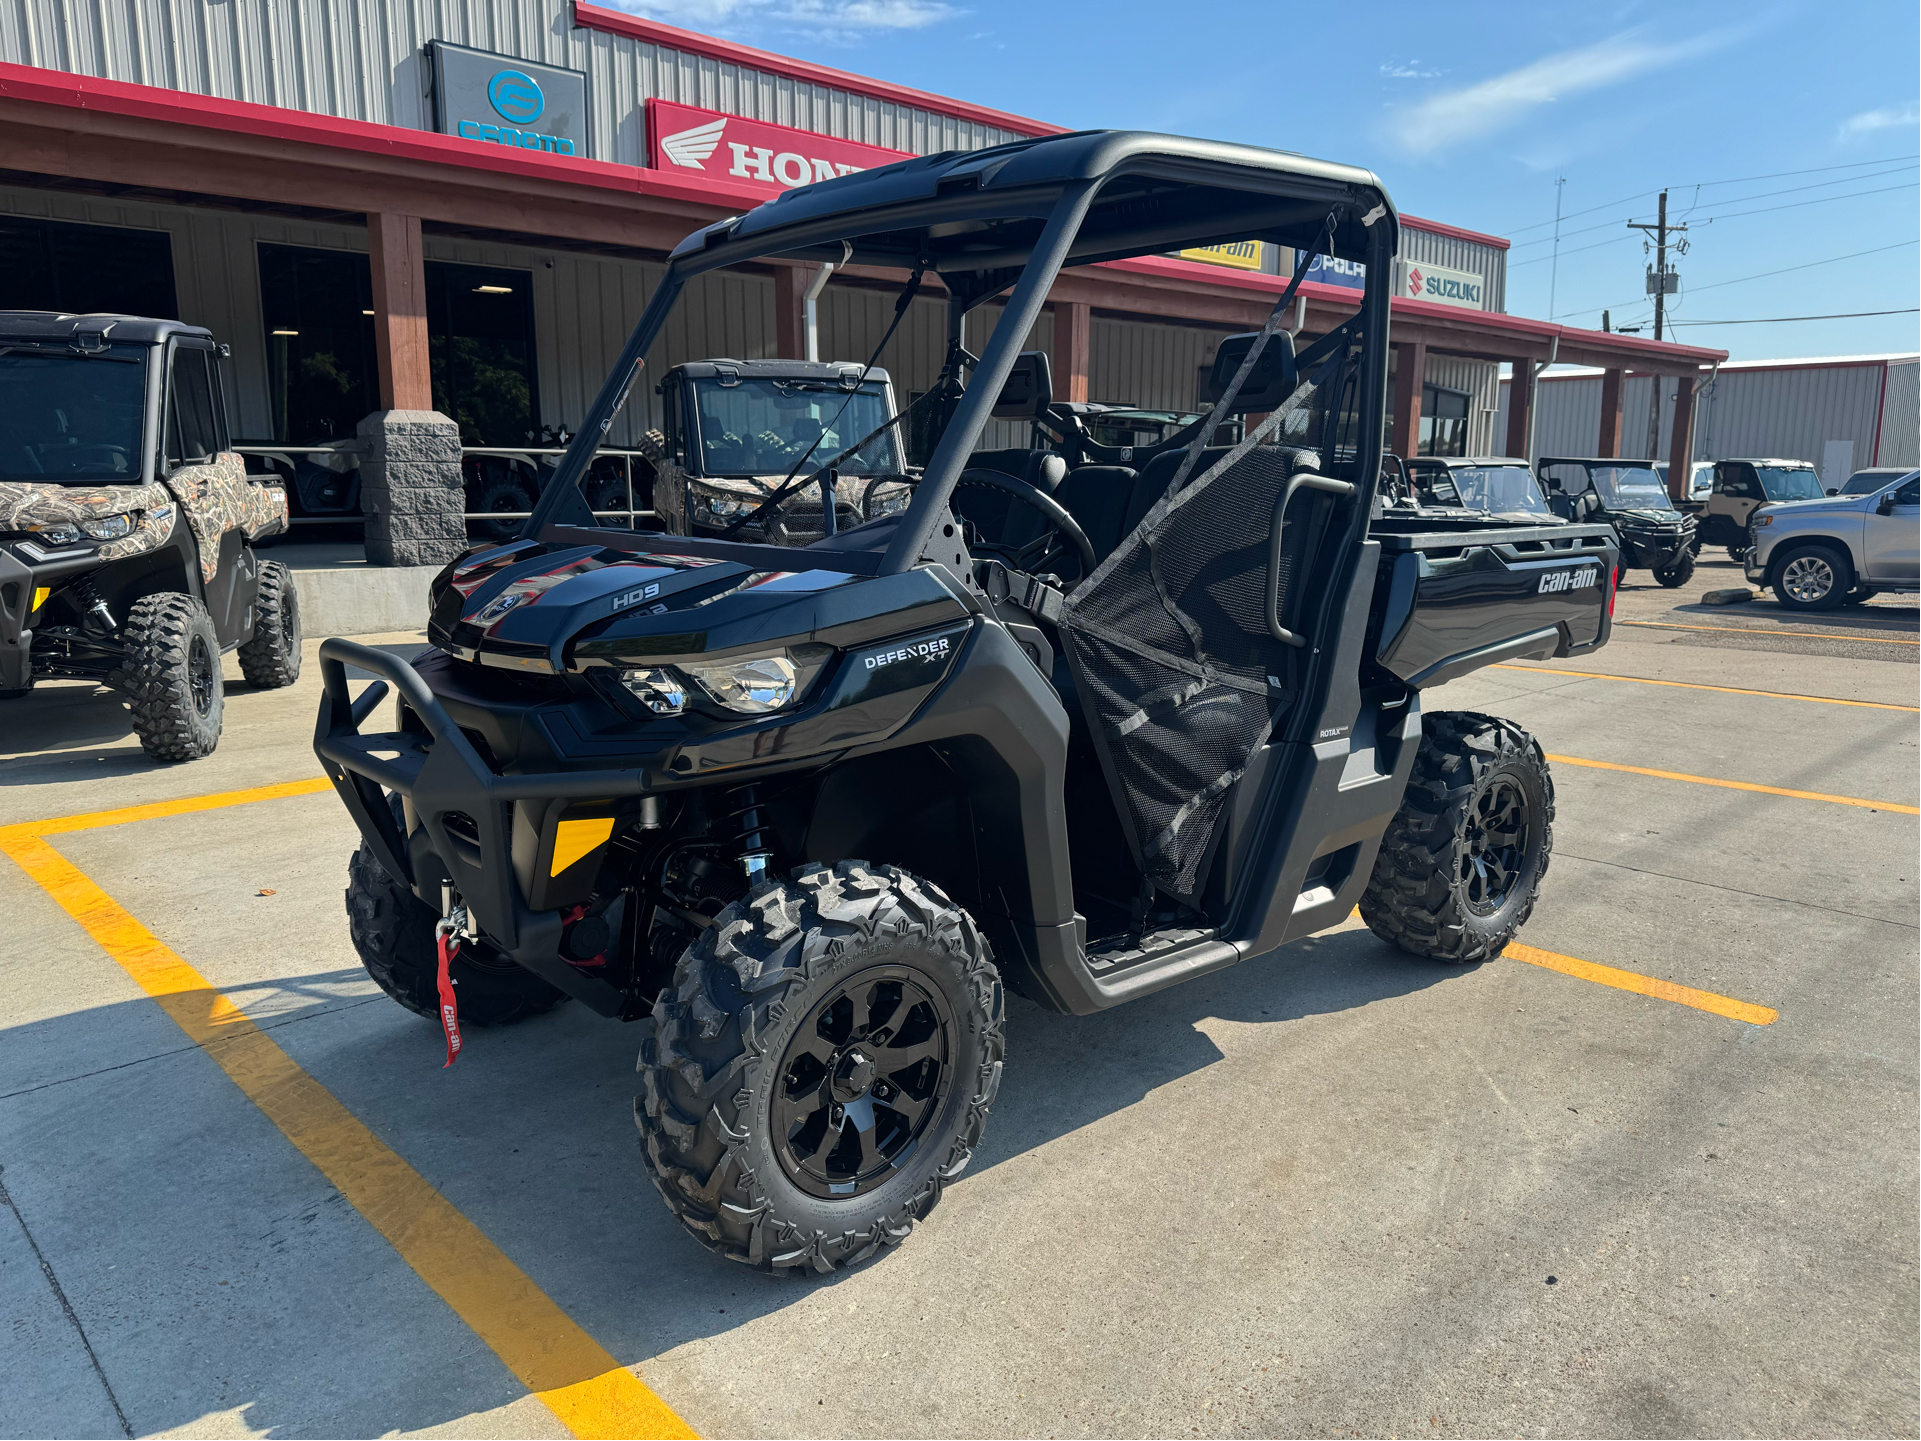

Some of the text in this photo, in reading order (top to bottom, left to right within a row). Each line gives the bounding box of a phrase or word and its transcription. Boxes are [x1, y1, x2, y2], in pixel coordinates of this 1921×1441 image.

[458, 120, 574, 156] CFMOTO
[727, 141, 867, 188] HON
[1322, 254, 1367, 278] POLA
[1426, 275, 1481, 303] SUZUKI
[1537, 568, 1598, 594] can-am
[613, 583, 660, 610] HD9
[864, 638, 950, 669] DEFENDER
[922, 649, 950, 664] XT
[1320, 728, 1341, 738] ROTAX
